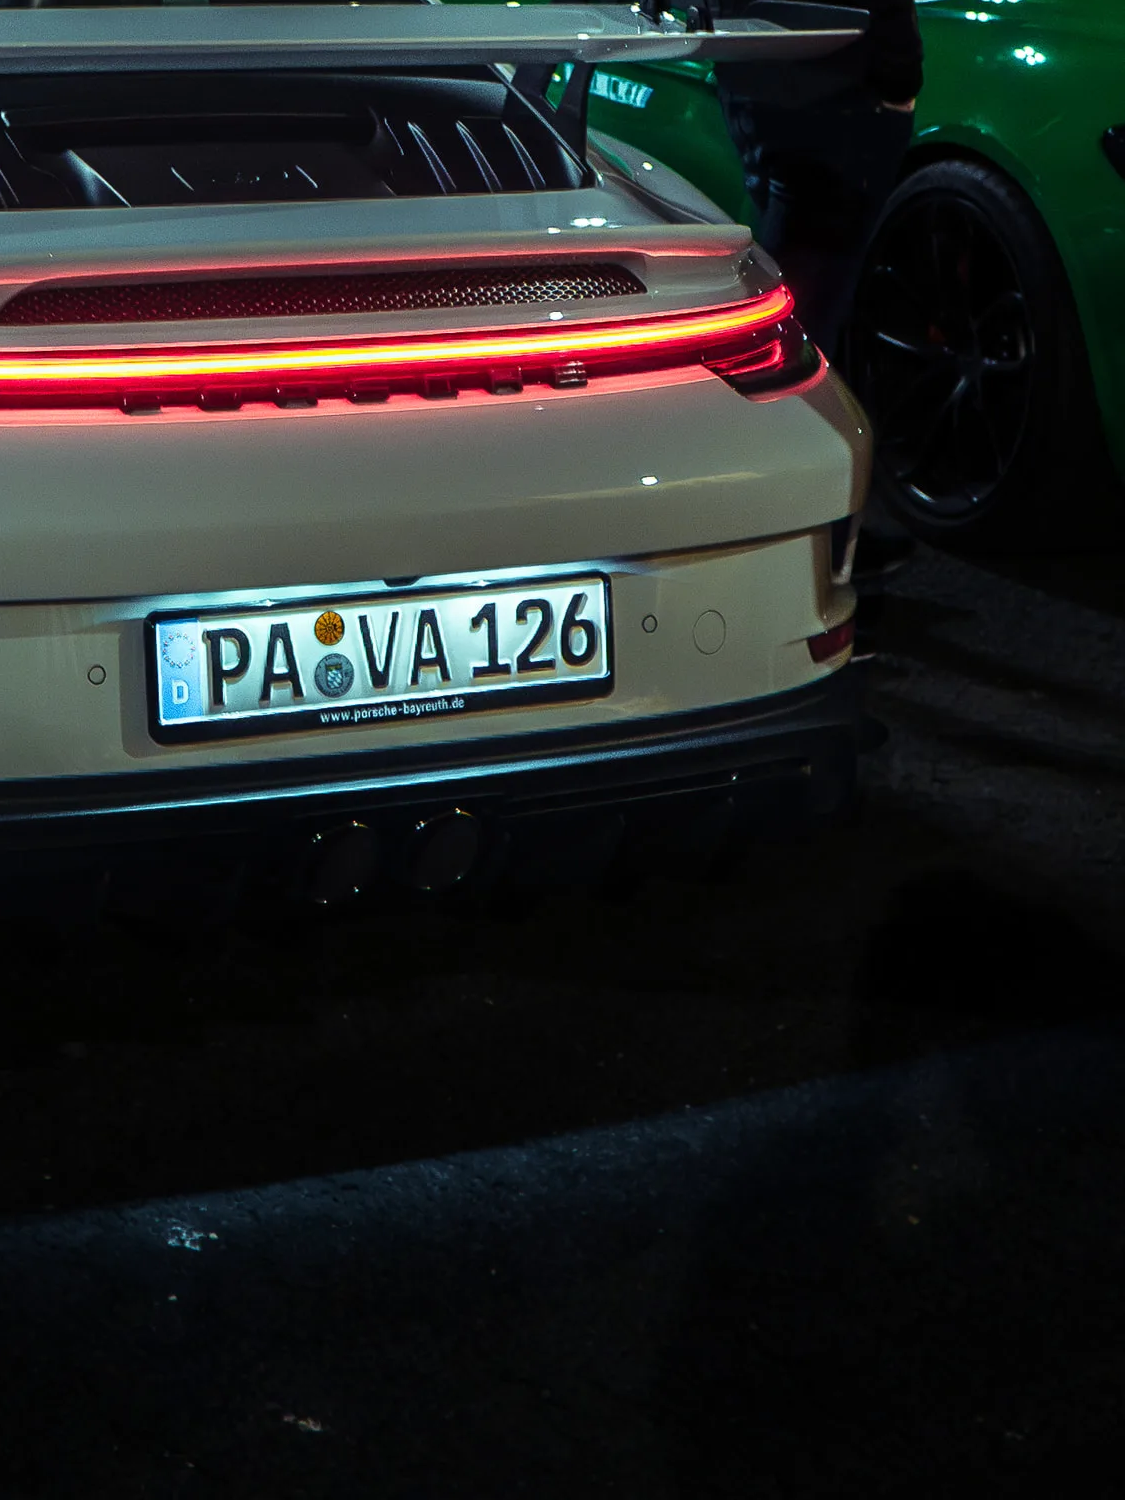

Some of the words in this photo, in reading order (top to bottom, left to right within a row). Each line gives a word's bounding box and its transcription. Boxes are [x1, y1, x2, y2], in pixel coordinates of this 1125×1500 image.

[204, 622, 304, 706] PA
[357, 610, 452, 688] VA
[470, 593, 596, 677] 126
[172, 680, 189, 704] D
[319, 697, 465, 724] www.porsche-bayreuth.de
